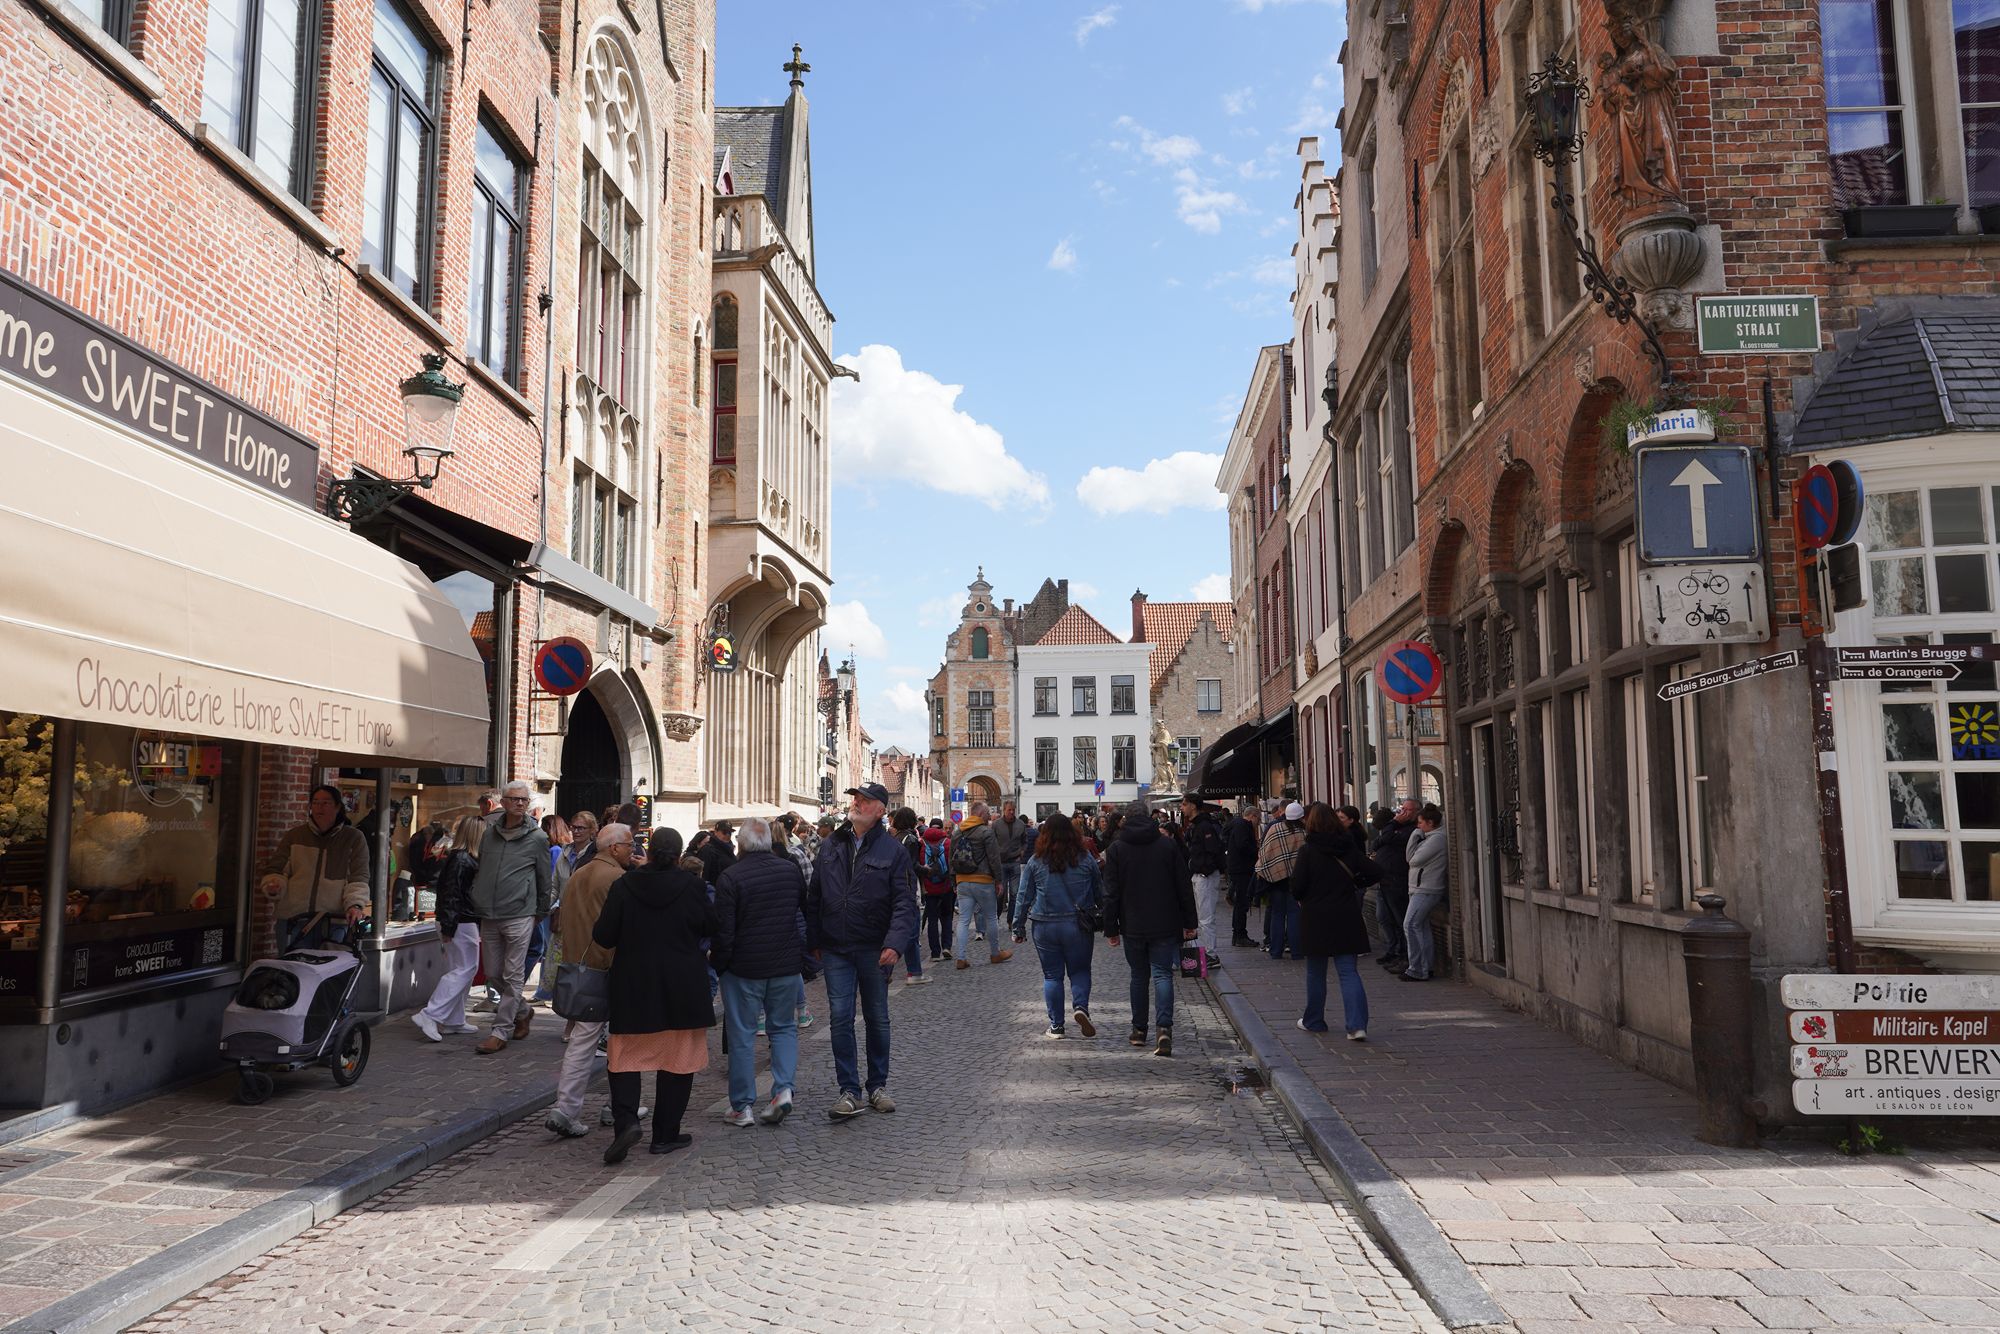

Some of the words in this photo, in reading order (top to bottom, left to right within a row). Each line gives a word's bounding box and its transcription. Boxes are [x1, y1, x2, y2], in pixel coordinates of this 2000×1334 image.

[1704, 303, 1799, 319] KARTUIZERINNEN
[1736, 322, 1781, 337] STRAAT
[82, 339, 214, 450] SWEET
[224, 411, 292, 489] Home
[1705, 628, 1716, 640] A
[1869, 649, 1918, 659] Martin's
[1921, 649, 1967, 661] Brugge
[1868, 667, 1882, 677] de
[1885, 667, 1943, 679] Orangerie
[1667, 681, 1698, 696] Relais
[1700, 673, 1732, 687] Bourg.
[76, 657, 225, 726] Chocolaterie
[233, 687, 284, 735] Home
[288, 696, 352, 742] SWEET
[356, 708, 394, 748] Home
[138, 741, 192, 767] SWEET
[115, 964, 133, 978] home
[135, 956, 165, 974] SWEET
[166, 956, 183, 969] home
[1872, 1016, 1940, 1036] Militaire
[1943, 1015, 1988, 1040] Kapel
[1845, 1087, 1865, 1099] art
[1877, 1087, 1941, 1101] antiques
[1947, 1102, 1974, 1110] LÉON
